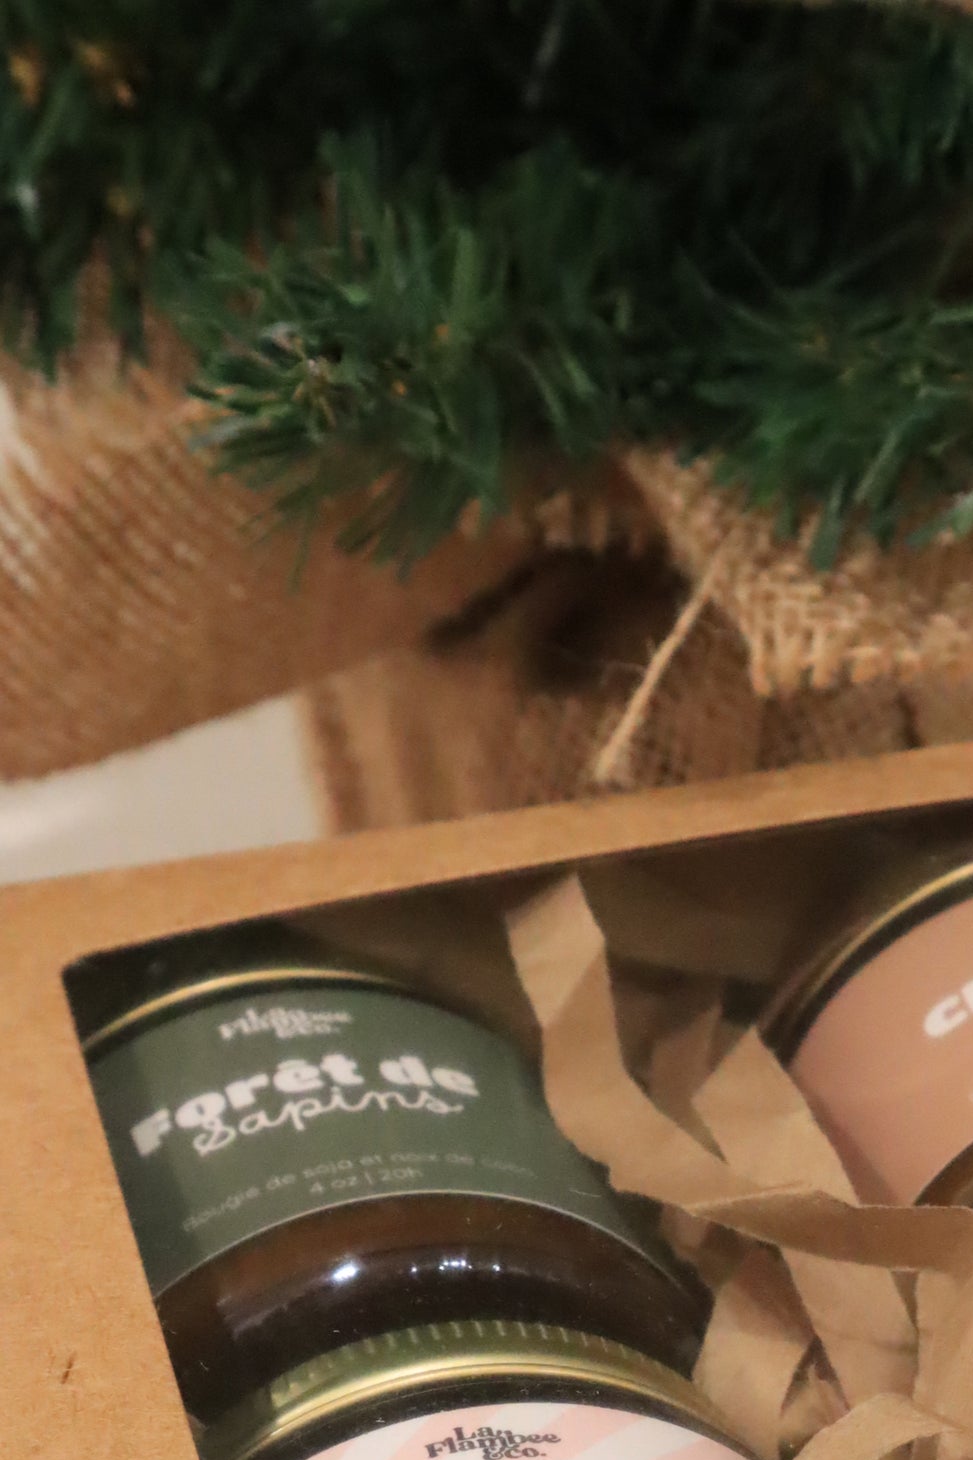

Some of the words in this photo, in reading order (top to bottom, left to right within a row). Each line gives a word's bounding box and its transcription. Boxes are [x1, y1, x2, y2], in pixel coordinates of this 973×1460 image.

[130, 1053, 365, 1157] Forêt
[378, 1055, 481, 1097] de
[424, 1429, 562, 1459] Flambee
[454, 1426, 494, 1441] La
